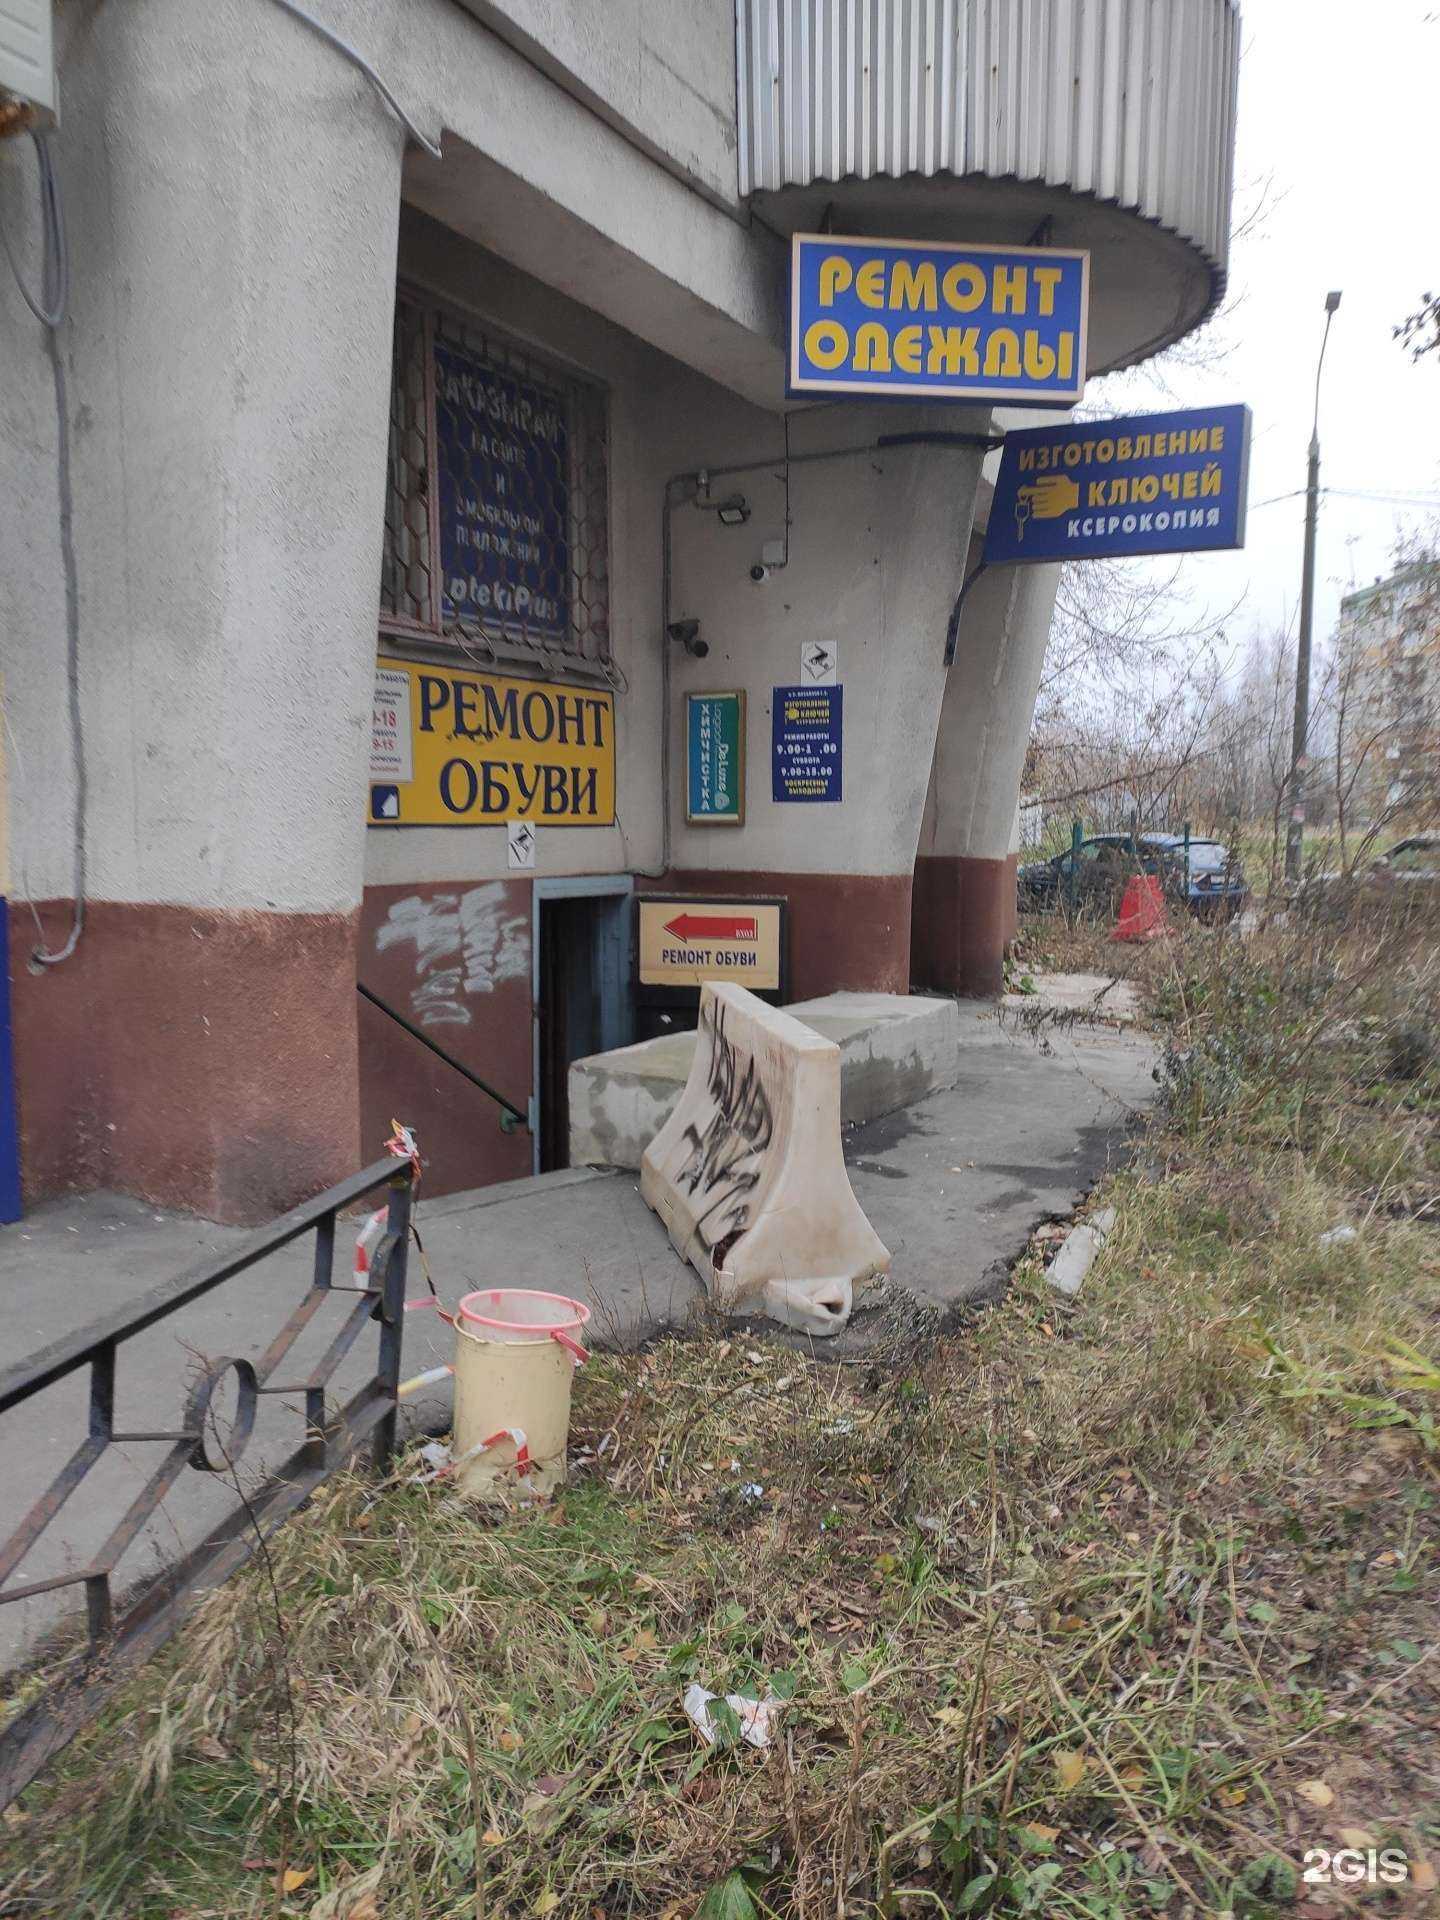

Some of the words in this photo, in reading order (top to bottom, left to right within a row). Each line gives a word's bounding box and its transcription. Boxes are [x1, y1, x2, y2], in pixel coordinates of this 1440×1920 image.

[818, 255, 1063, 317] РЕМОНТ
[803, 319, 1075, 381] ОДЕЖДЫ
[1018, 425, 1226, 472] ИЗГОТОВЛЕНИЕ
[1087, 461, 1223, 508] КЛЮЧЕЙ
[1067, 507, 1220, 538] КСЕРОКОПИЯ
[418, 675, 610, 748] РЕМОНТ
[439, 757, 598, 816] ОБУВИ
[701, 703, 711, 811] ХИМЧИСТКА
[662, 948, 712, 965] РЕМОНТ
[715, 950, 757, 967] ОБУВИ
